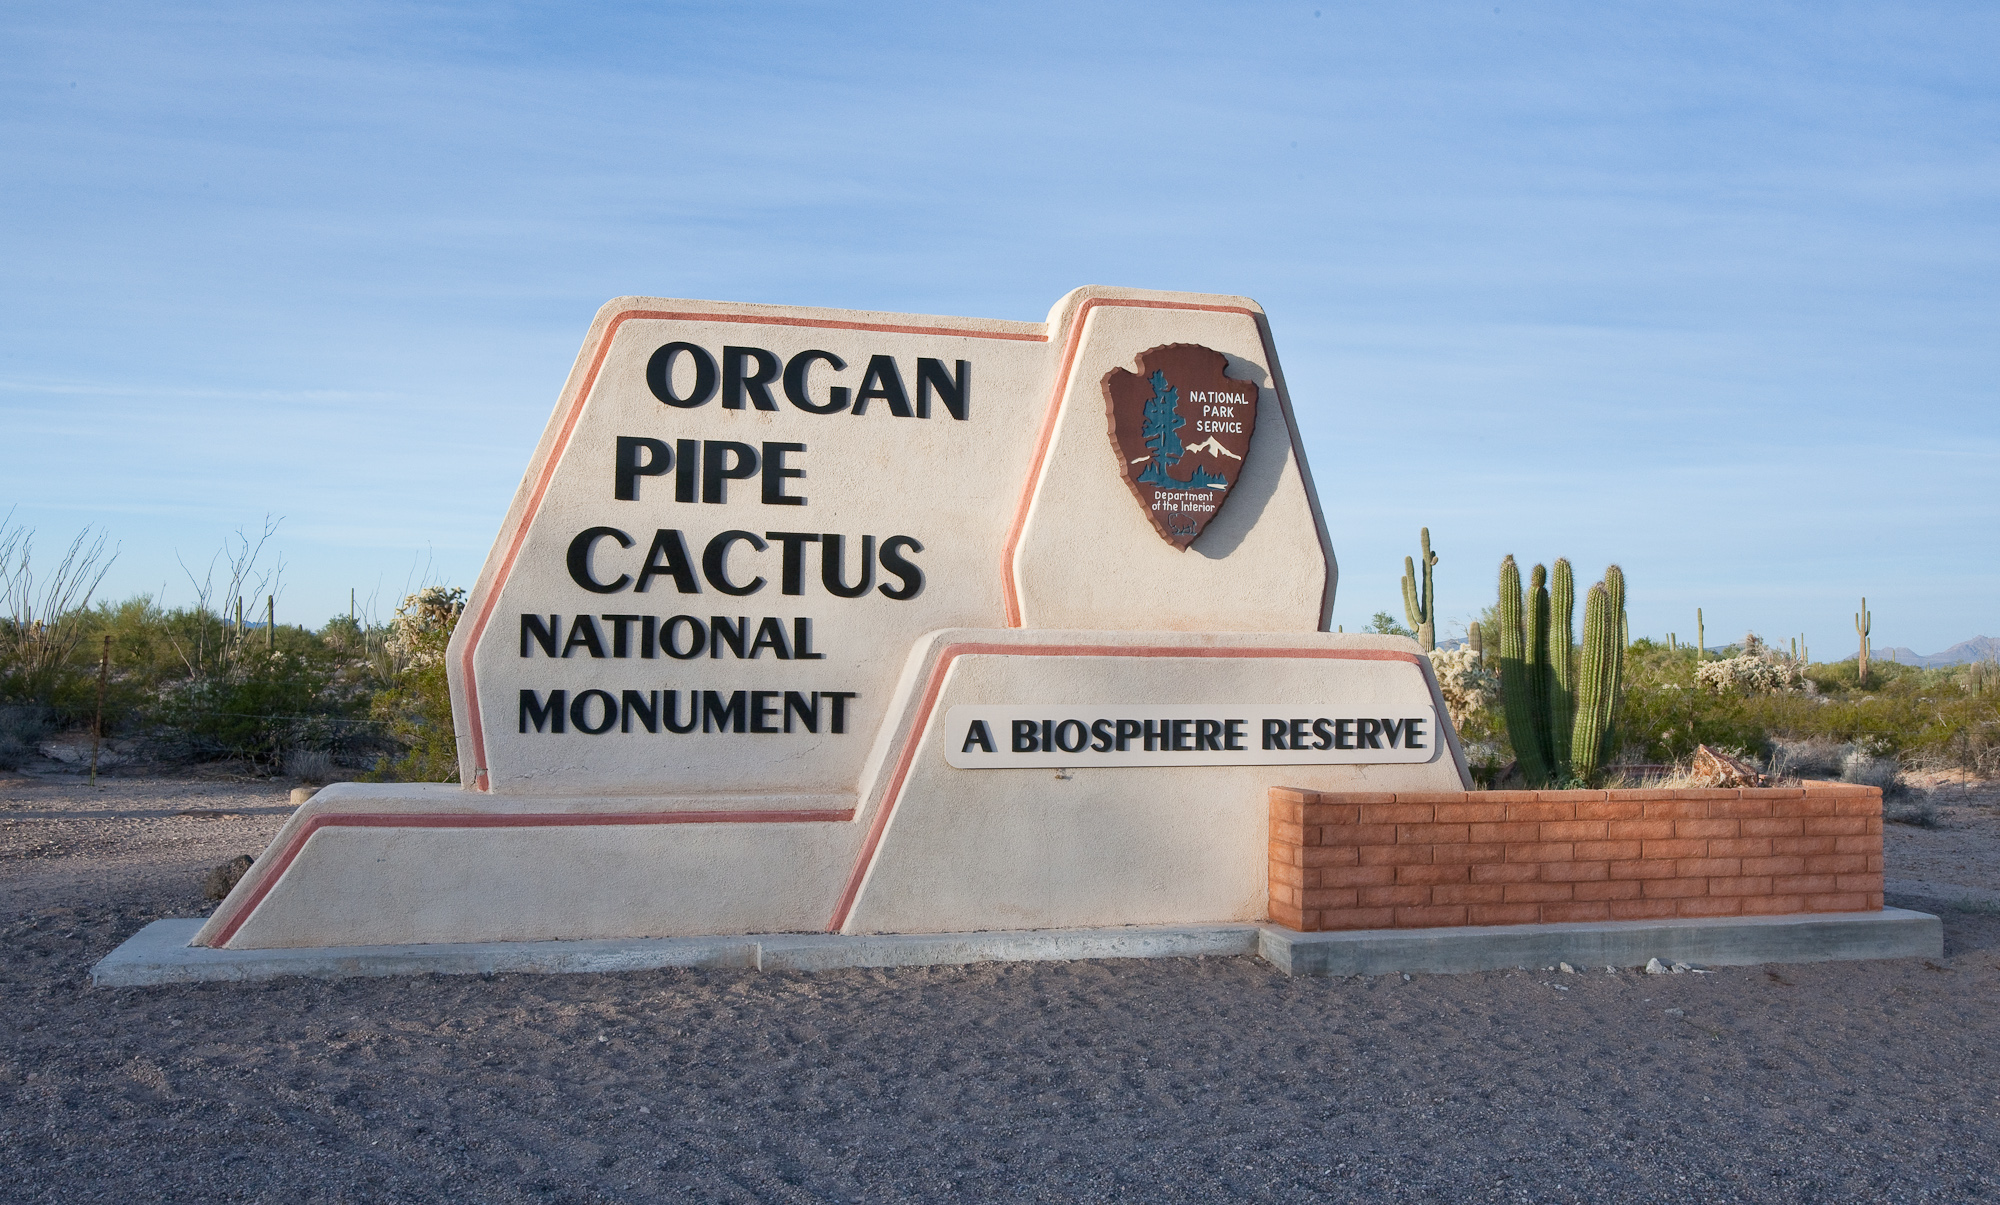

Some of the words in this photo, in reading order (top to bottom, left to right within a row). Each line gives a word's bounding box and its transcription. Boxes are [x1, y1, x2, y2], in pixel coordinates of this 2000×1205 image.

[645, 341, 967, 421] ORGAN
[1189, 391, 1249, 405] NATIONAL
[1196, 420, 1243, 434] SERVICE
[1203, 405, 1235, 418] PARK
[614, 435, 807, 506] PIPE
[1151, 502, 1161, 512] of
[1162, 501, 1179, 512] the
[1181, 501, 1216, 513] Interior
[1154, 490, 1214, 502] Department
[566, 526, 924, 601] CACTUS
[519, 613, 823, 660] NATIONAL
[518, 689, 857, 735] MONUMENT
[961, 719, 994, 753] A
[1011, 718, 1246, 754] BIOSPHERE
[1262, 717, 1426, 751] RESERVE
